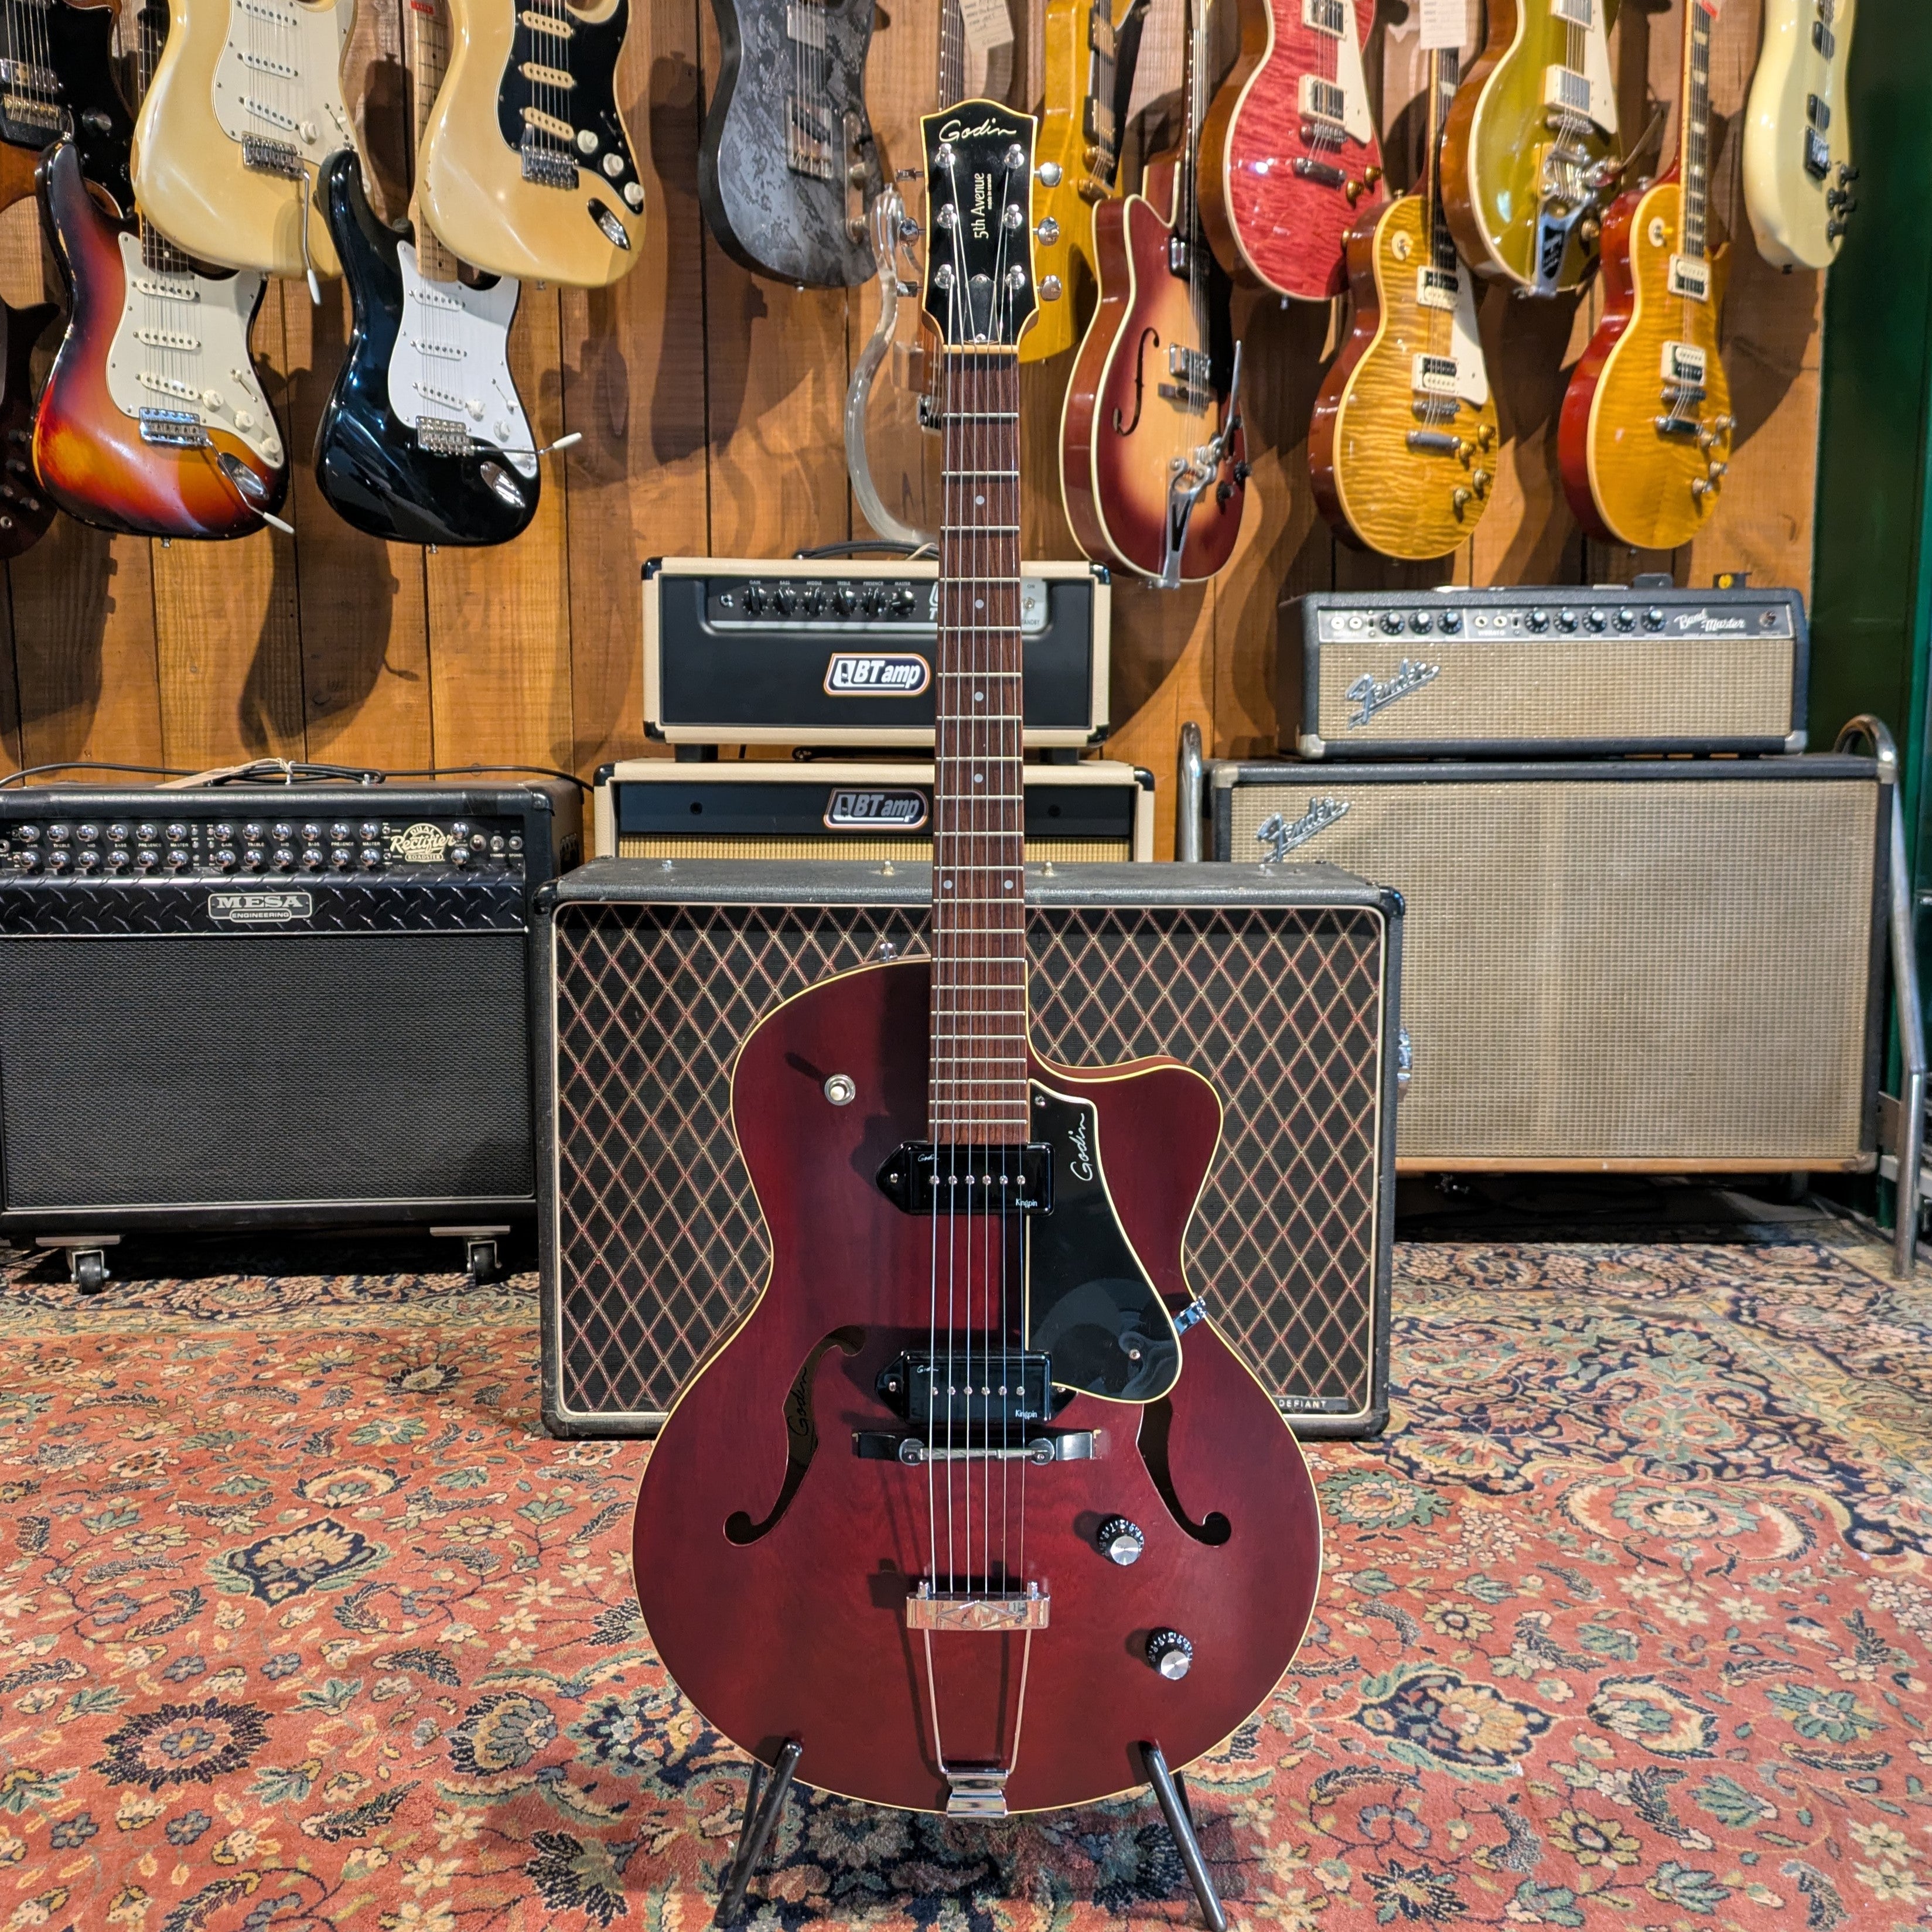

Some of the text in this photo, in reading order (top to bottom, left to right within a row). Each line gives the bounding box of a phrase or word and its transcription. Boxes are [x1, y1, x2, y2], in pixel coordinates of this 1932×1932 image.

[939, 118, 1016, 142] Godin
[970, 172, 989, 239] 5th Avenue
[854, 660, 920, 689] BT amp
[1346, 658, 1440, 730] Fender
[853, 794, 920, 822] BT amp
[410, 825, 435, 835] DUAL
[1256, 797, 1351, 863] Fender
[390, 834, 456, 854] Rectifier
[217, 896, 303, 909] MESA
[917, 1153, 940, 1162] Godi
[1068, 1112, 1093, 1181] Godin
[1279, 1399, 1327, 1409] DEFIANT
